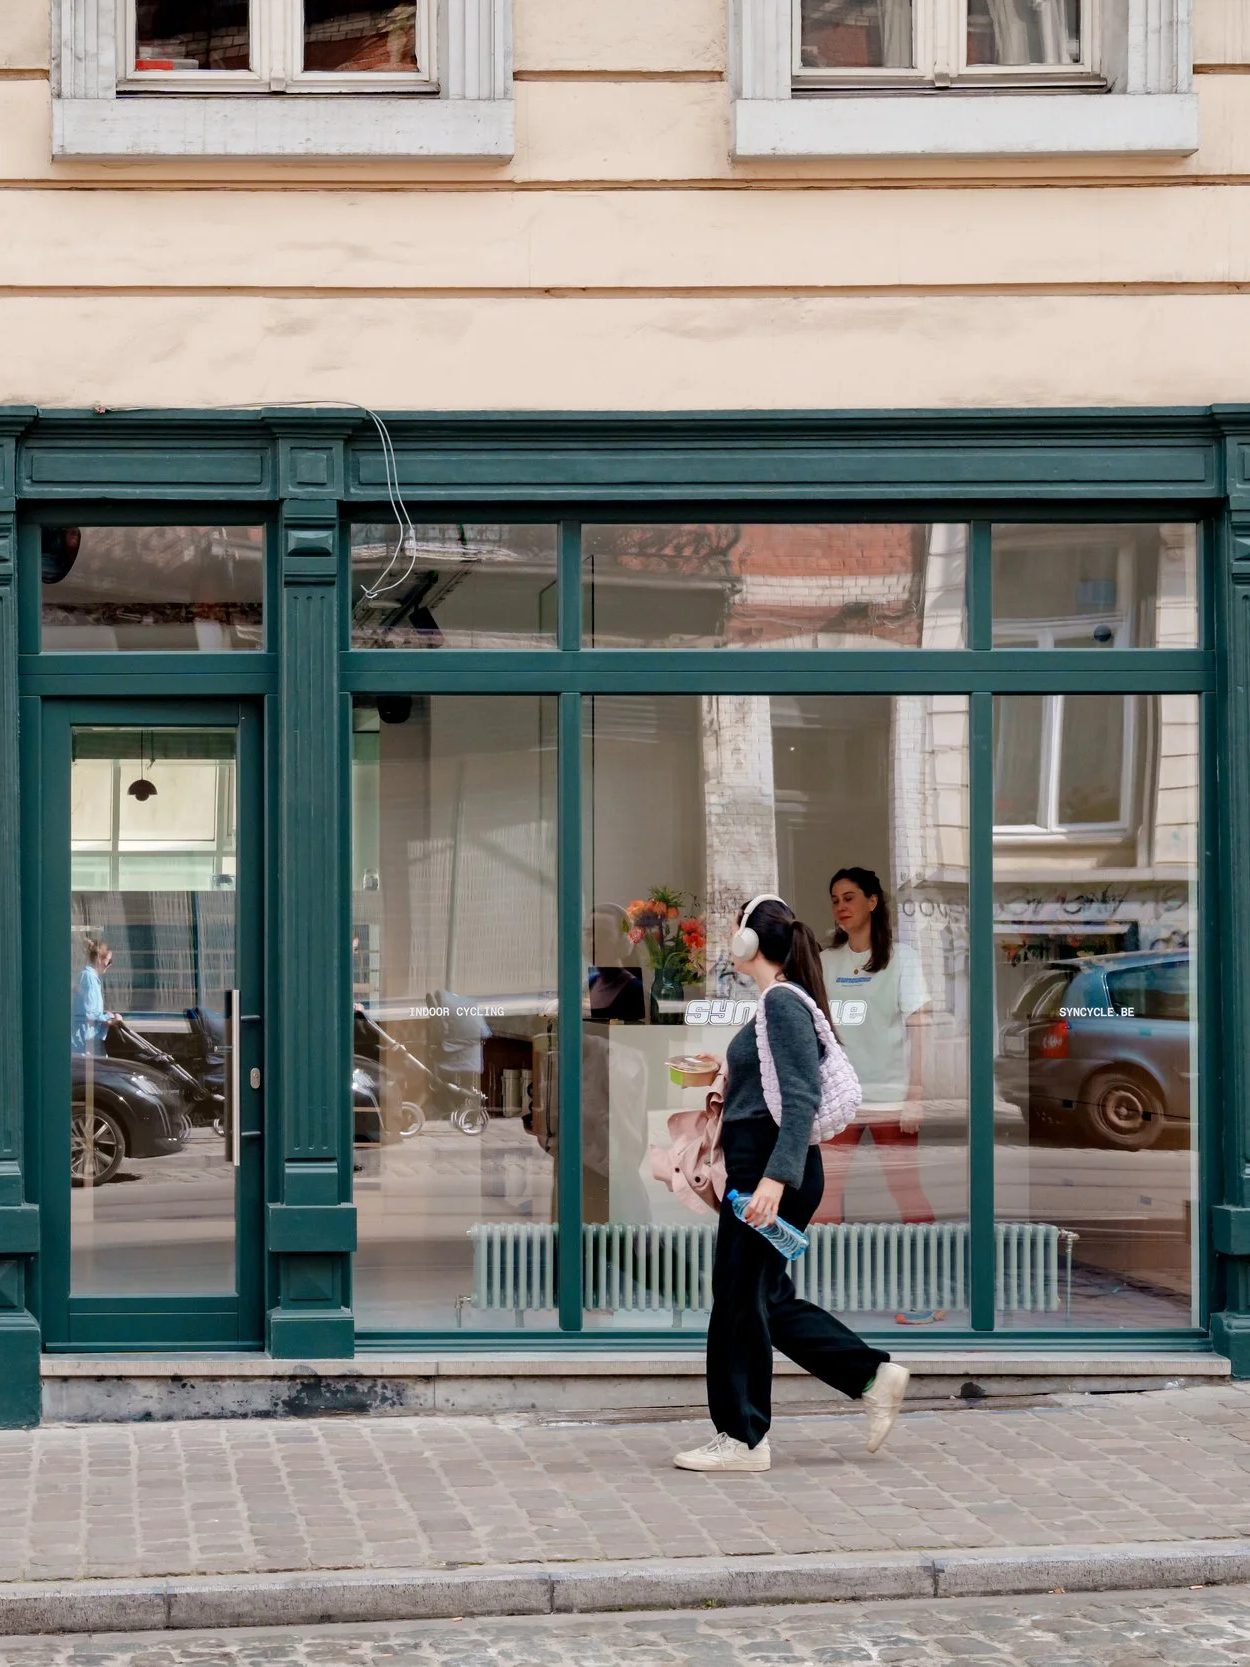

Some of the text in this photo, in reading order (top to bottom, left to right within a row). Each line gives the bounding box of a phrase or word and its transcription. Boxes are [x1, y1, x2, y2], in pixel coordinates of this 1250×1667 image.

[409, 1006, 505, 1017] INDOOR CYCLING
[684, 999, 868, 1026] synle
[1059, 1007, 1135, 1017] SYNCYCLE.BE
